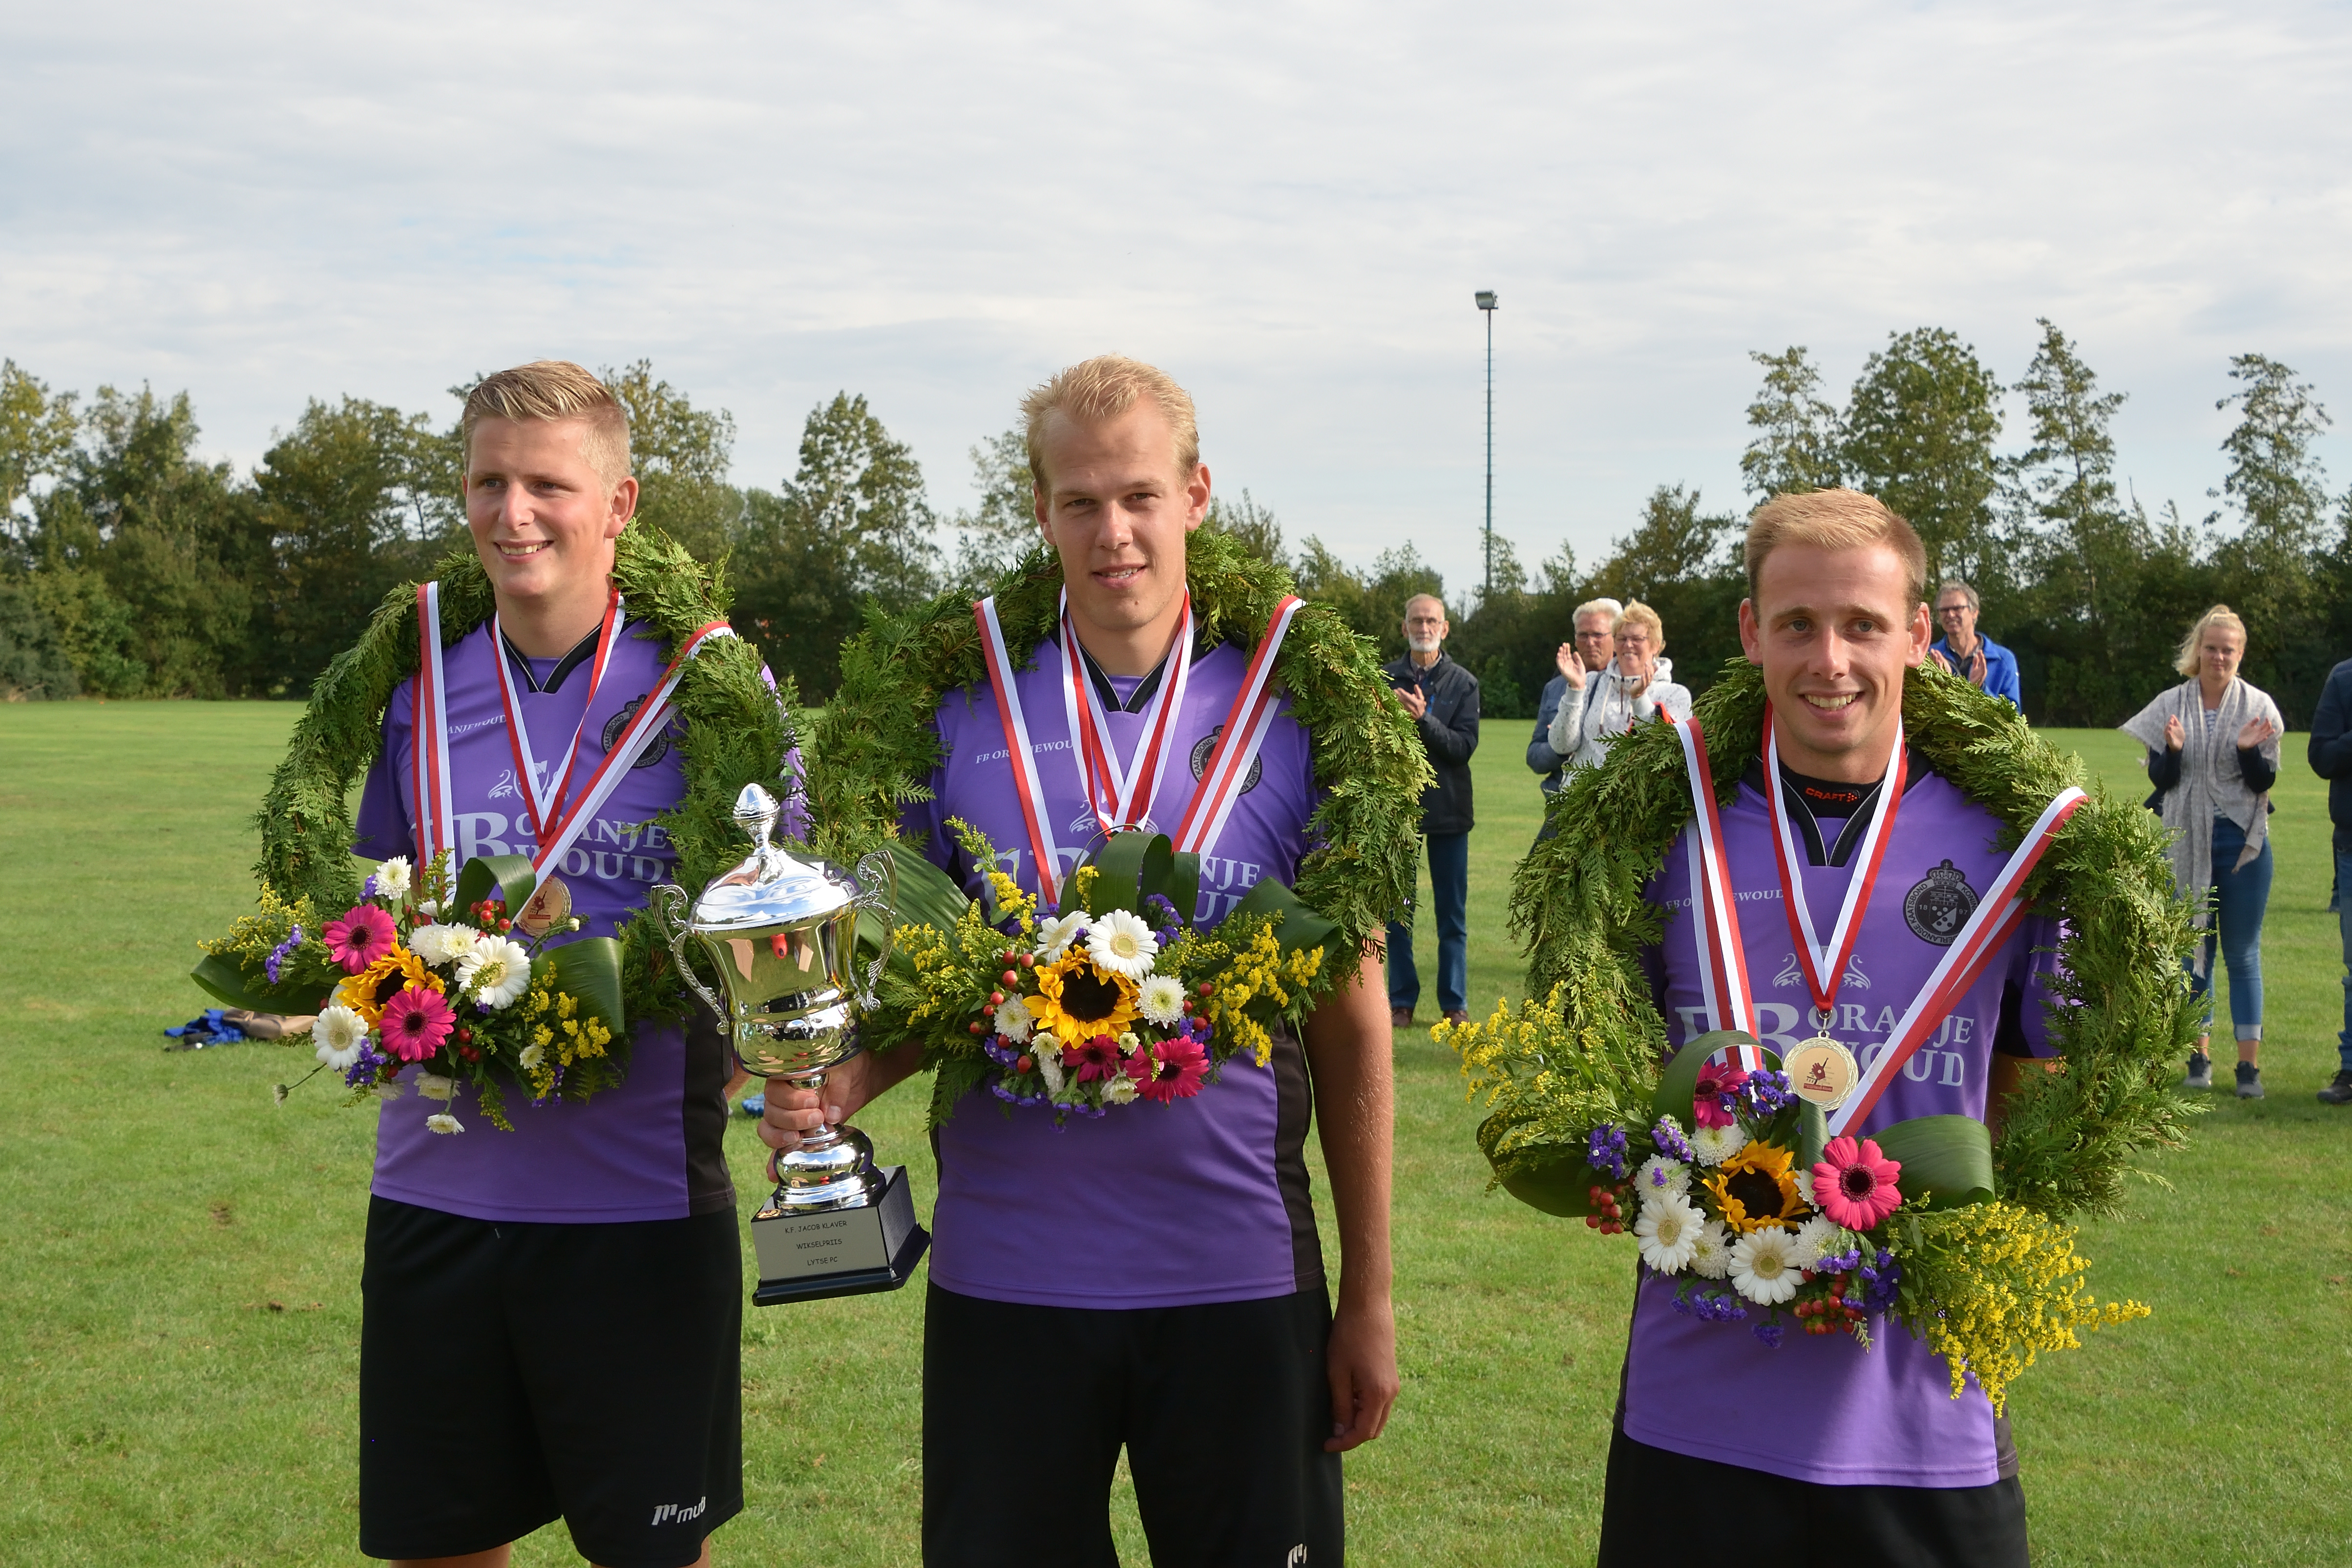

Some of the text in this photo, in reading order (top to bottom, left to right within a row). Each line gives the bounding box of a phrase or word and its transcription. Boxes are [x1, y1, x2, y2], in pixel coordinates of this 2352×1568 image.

[605, 715, 624, 749] KAATSBOND
[976, 753, 989, 764] FB
[1193, 738, 1213, 775] KAATSBOND
[1806, 787, 1846, 801] CRAFT
[515, 812, 667, 853] OANJE
[1907, 883, 1928, 924] KAATSBOND
[1807, 1004, 1974, 1048] ORAJE
[798, 1224, 820, 1232] JACOB
[822, 1220, 847, 1229] KLAVER
[797, 1239, 842, 1250] WIKSELPRIIS
[807, 1257, 828, 1266] LYTSE
